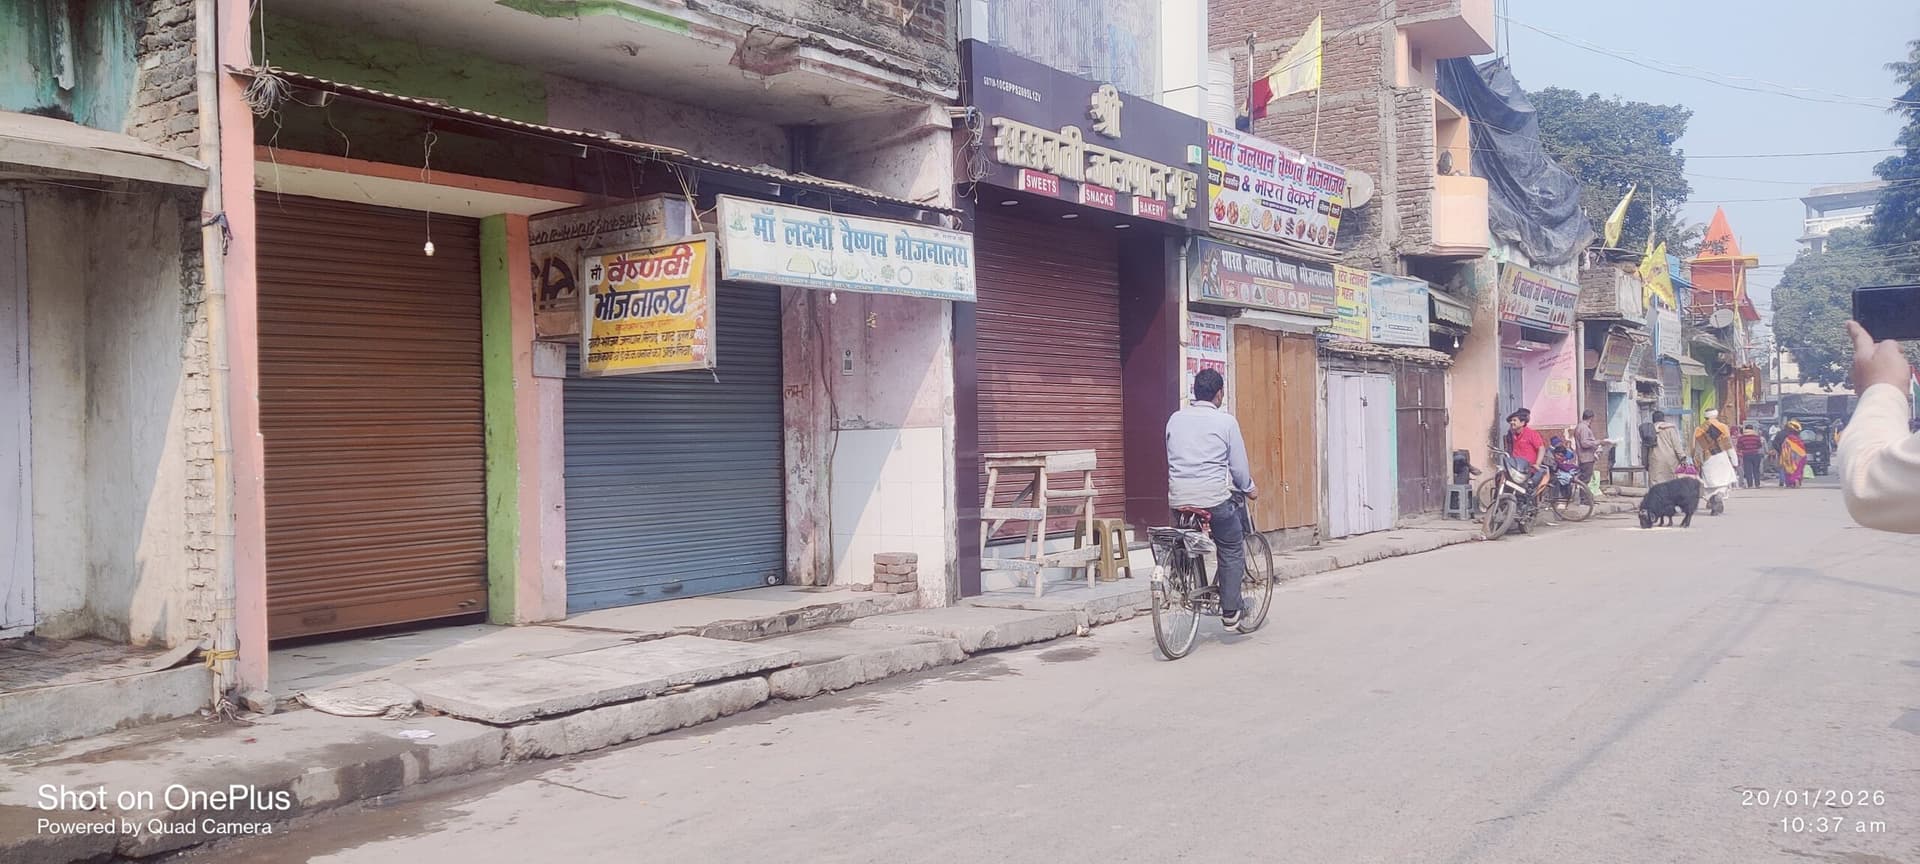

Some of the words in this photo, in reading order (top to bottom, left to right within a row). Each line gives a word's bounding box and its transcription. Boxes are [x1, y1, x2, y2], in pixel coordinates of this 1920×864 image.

[1089, 84, 1123, 138] श्री
[992, 117, 1085, 182] सरस्वती
[1084, 143, 1166, 201] जलपान
[1238, 143, 1275, 174] जलपान
[1278, 150, 1305, 182] वैष्णव
[1026, 175, 1057, 193] SWEETS
[1086, 189, 1114, 207] SNACKS
[1241, 175, 1250, 192] &
[1255, 178, 1284, 201] भारत
[1139, 201, 1164, 217] BAKERY
[751, 207, 776, 243] माँ
[840, 219, 888, 258] वैष्णव
[895, 229, 969, 269] भोजनालय
[608, 244, 693, 282] वैष्णवी
[595, 285, 691, 320] भोजनालय
